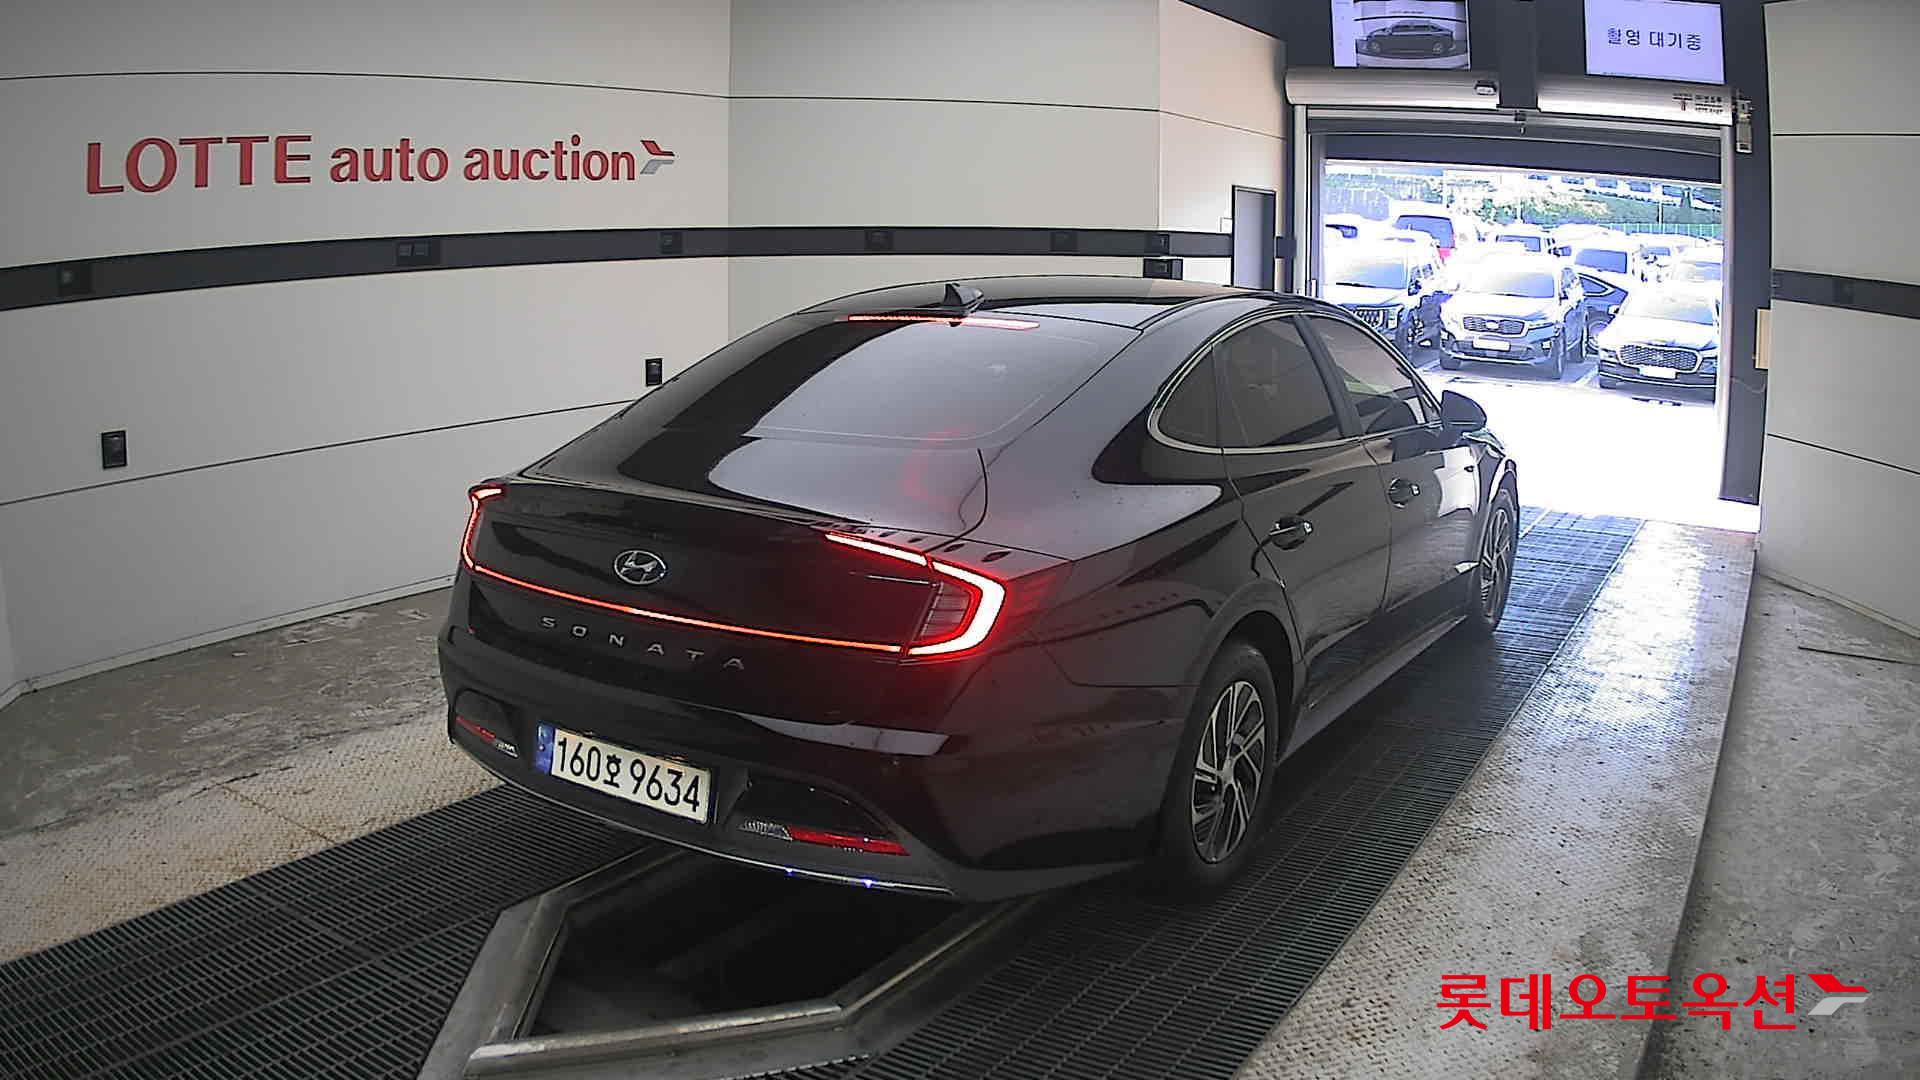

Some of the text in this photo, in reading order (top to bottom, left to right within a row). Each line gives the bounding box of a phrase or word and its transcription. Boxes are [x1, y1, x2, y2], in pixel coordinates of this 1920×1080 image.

[1649, 31, 1702, 51] 대기중
[86, 134, 636, 194] LOTTE auto auction
[541, 617, 744, 670] SONATA
[558, 738, 700, 812] 160호 9634
